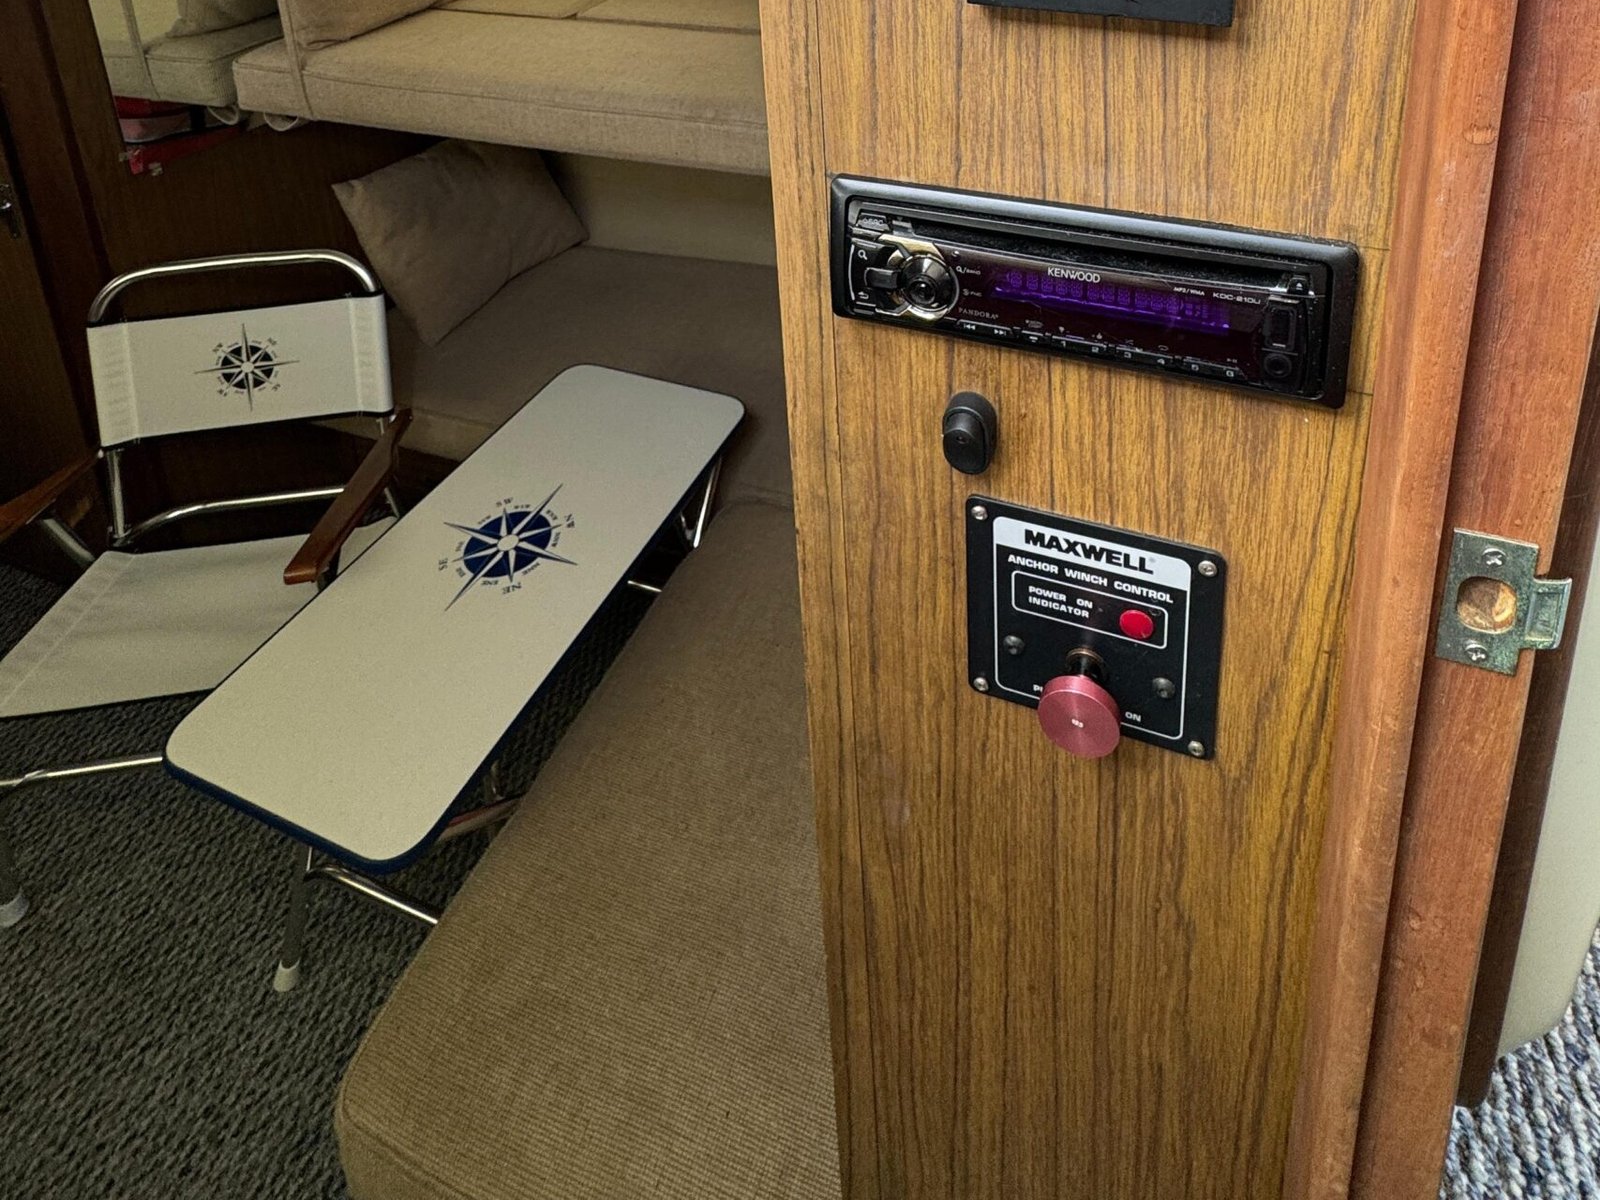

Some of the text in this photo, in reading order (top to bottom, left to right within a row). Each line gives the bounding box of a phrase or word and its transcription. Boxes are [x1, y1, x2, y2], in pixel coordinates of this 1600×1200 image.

[1047, 267, 1101, 283] KENWOOD
[1024, 528, 1154, 575] MAXWELL
[1007, 554, 1174, 604] ANCHOR WINCH CONTROL
[1028, 585, 1093, 609] POWER ON
[1028, 596, 1090, 619] INDICATOR
[1125, 711, 1142, 722] ON
